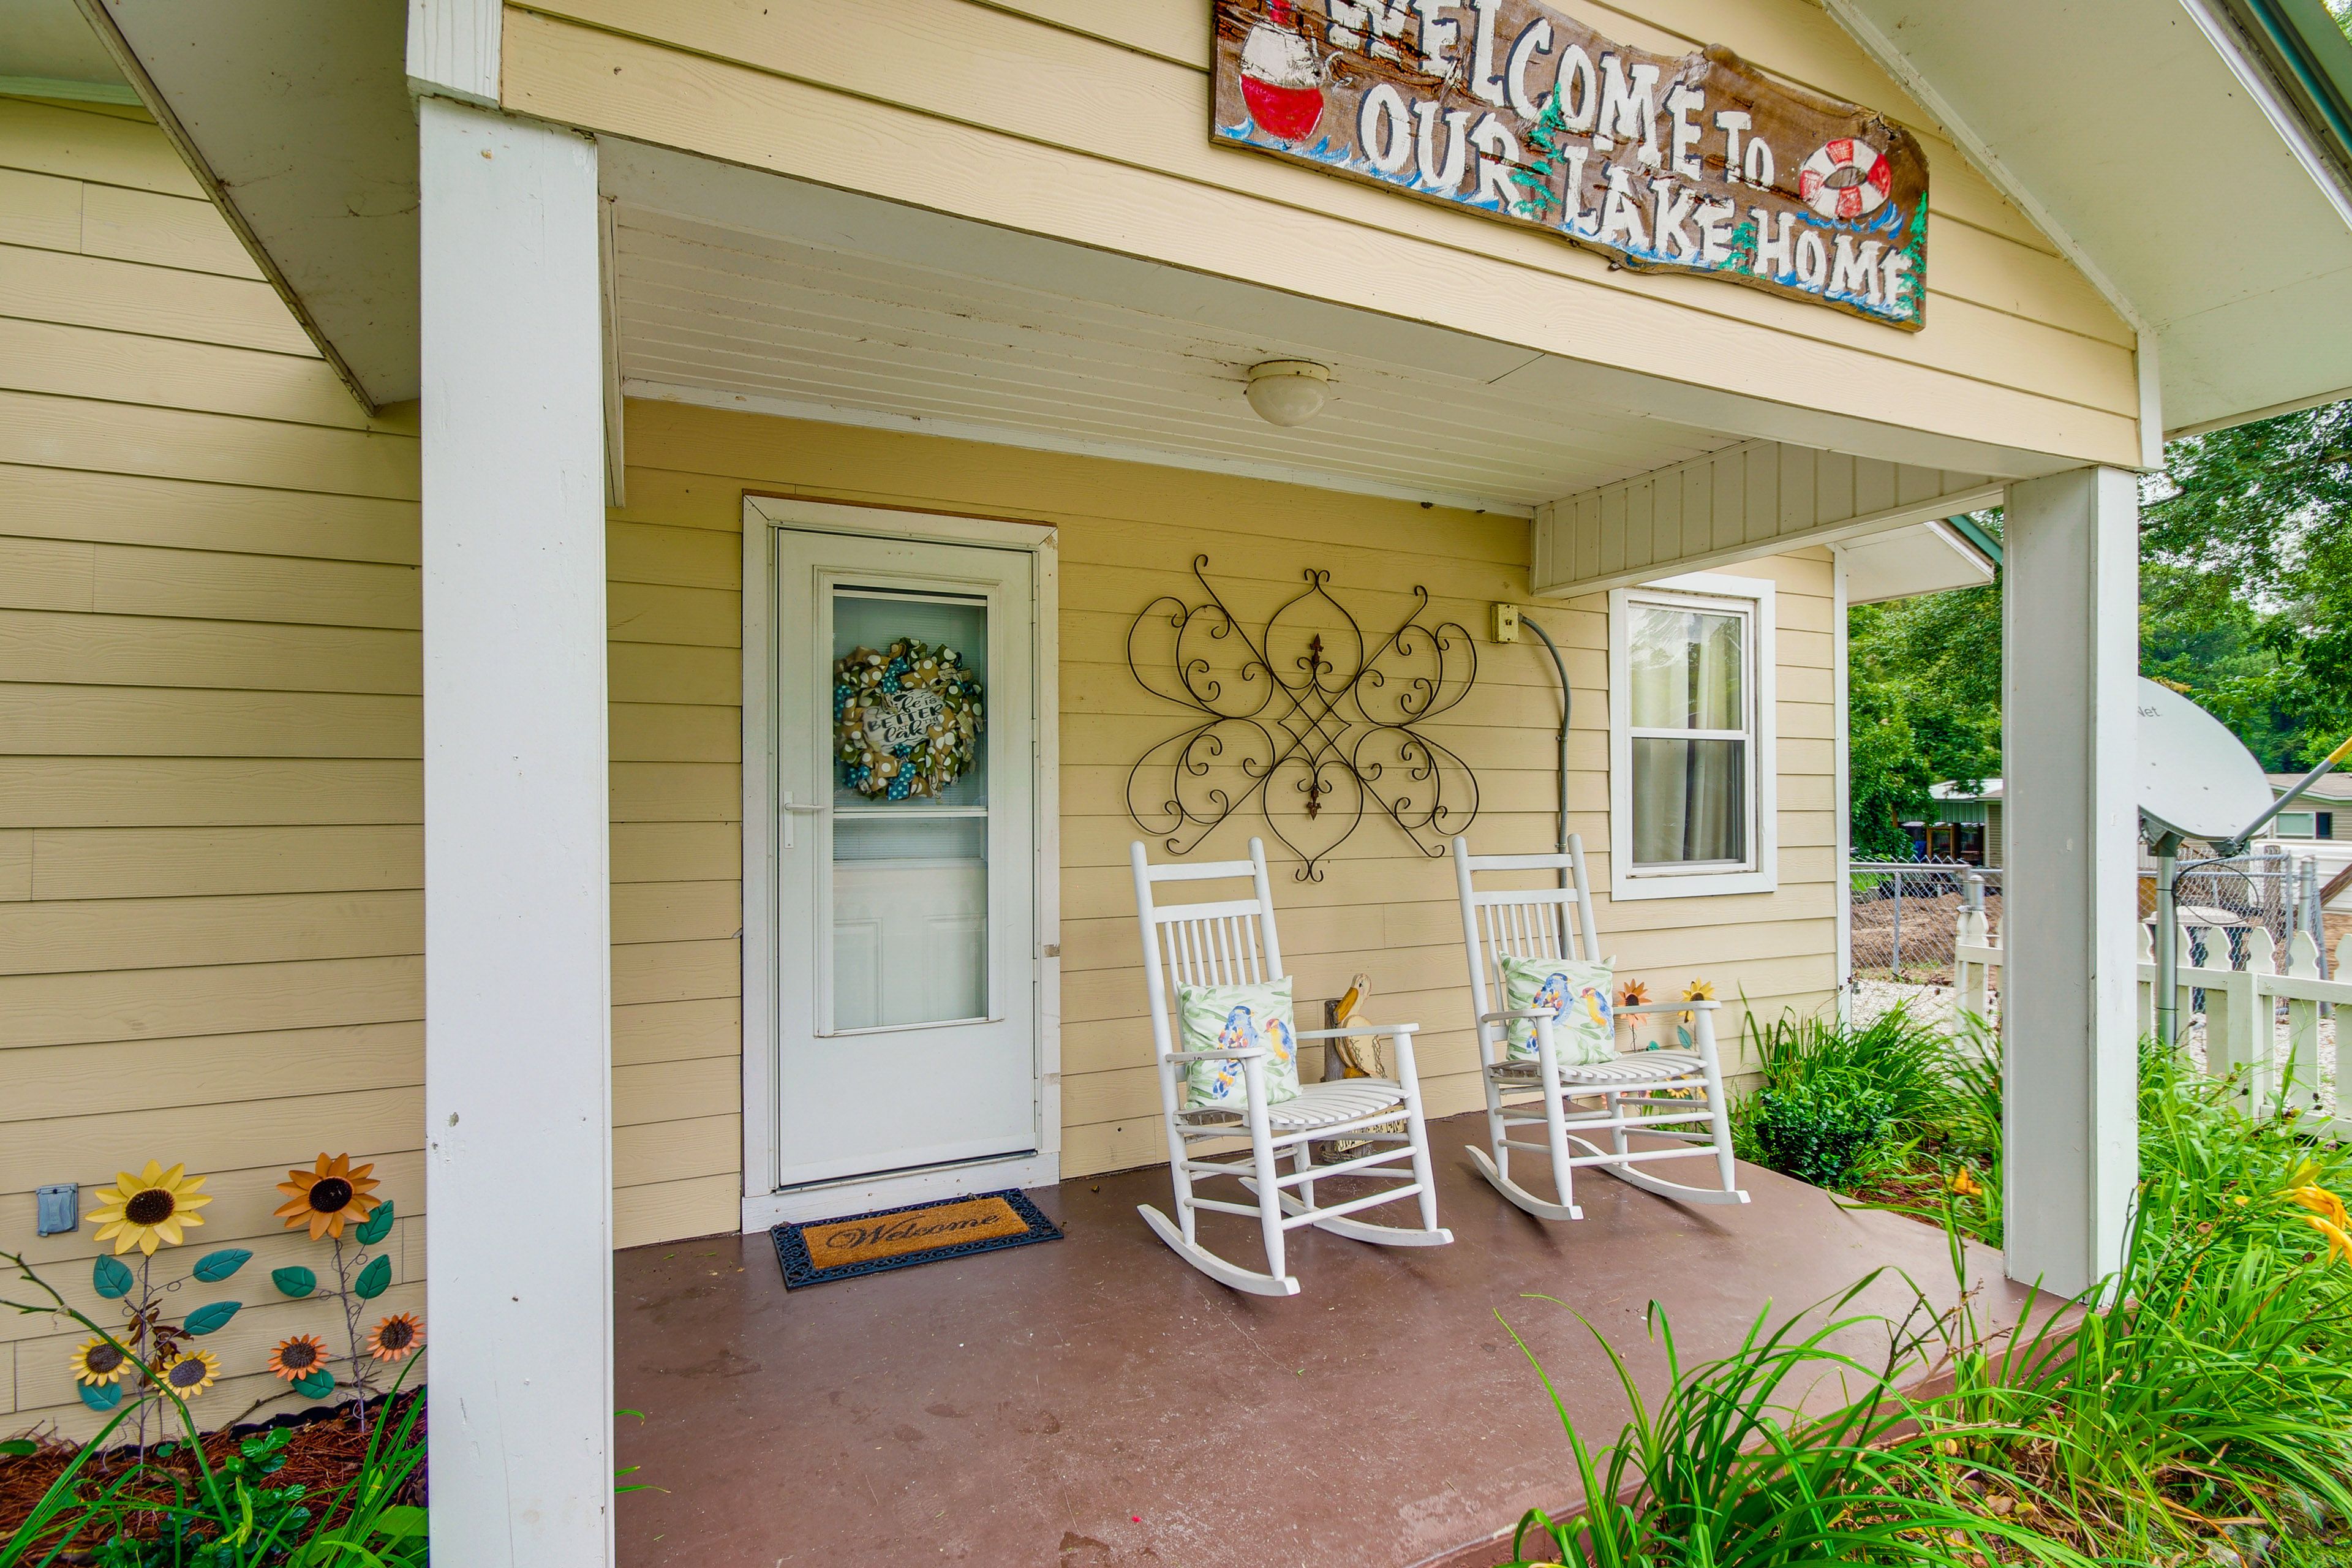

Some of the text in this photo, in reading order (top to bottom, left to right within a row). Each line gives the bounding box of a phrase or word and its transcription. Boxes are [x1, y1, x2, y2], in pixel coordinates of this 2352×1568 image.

[1325, 0, 1706, 182] WELCOME
[1359, 83, 1914, 318] OUR LAKE HOME
[867, 704, 943, 732] BETTER
[897, 724, 909, 733] AT
[825, 1214, 1001, 1250] Welcome
